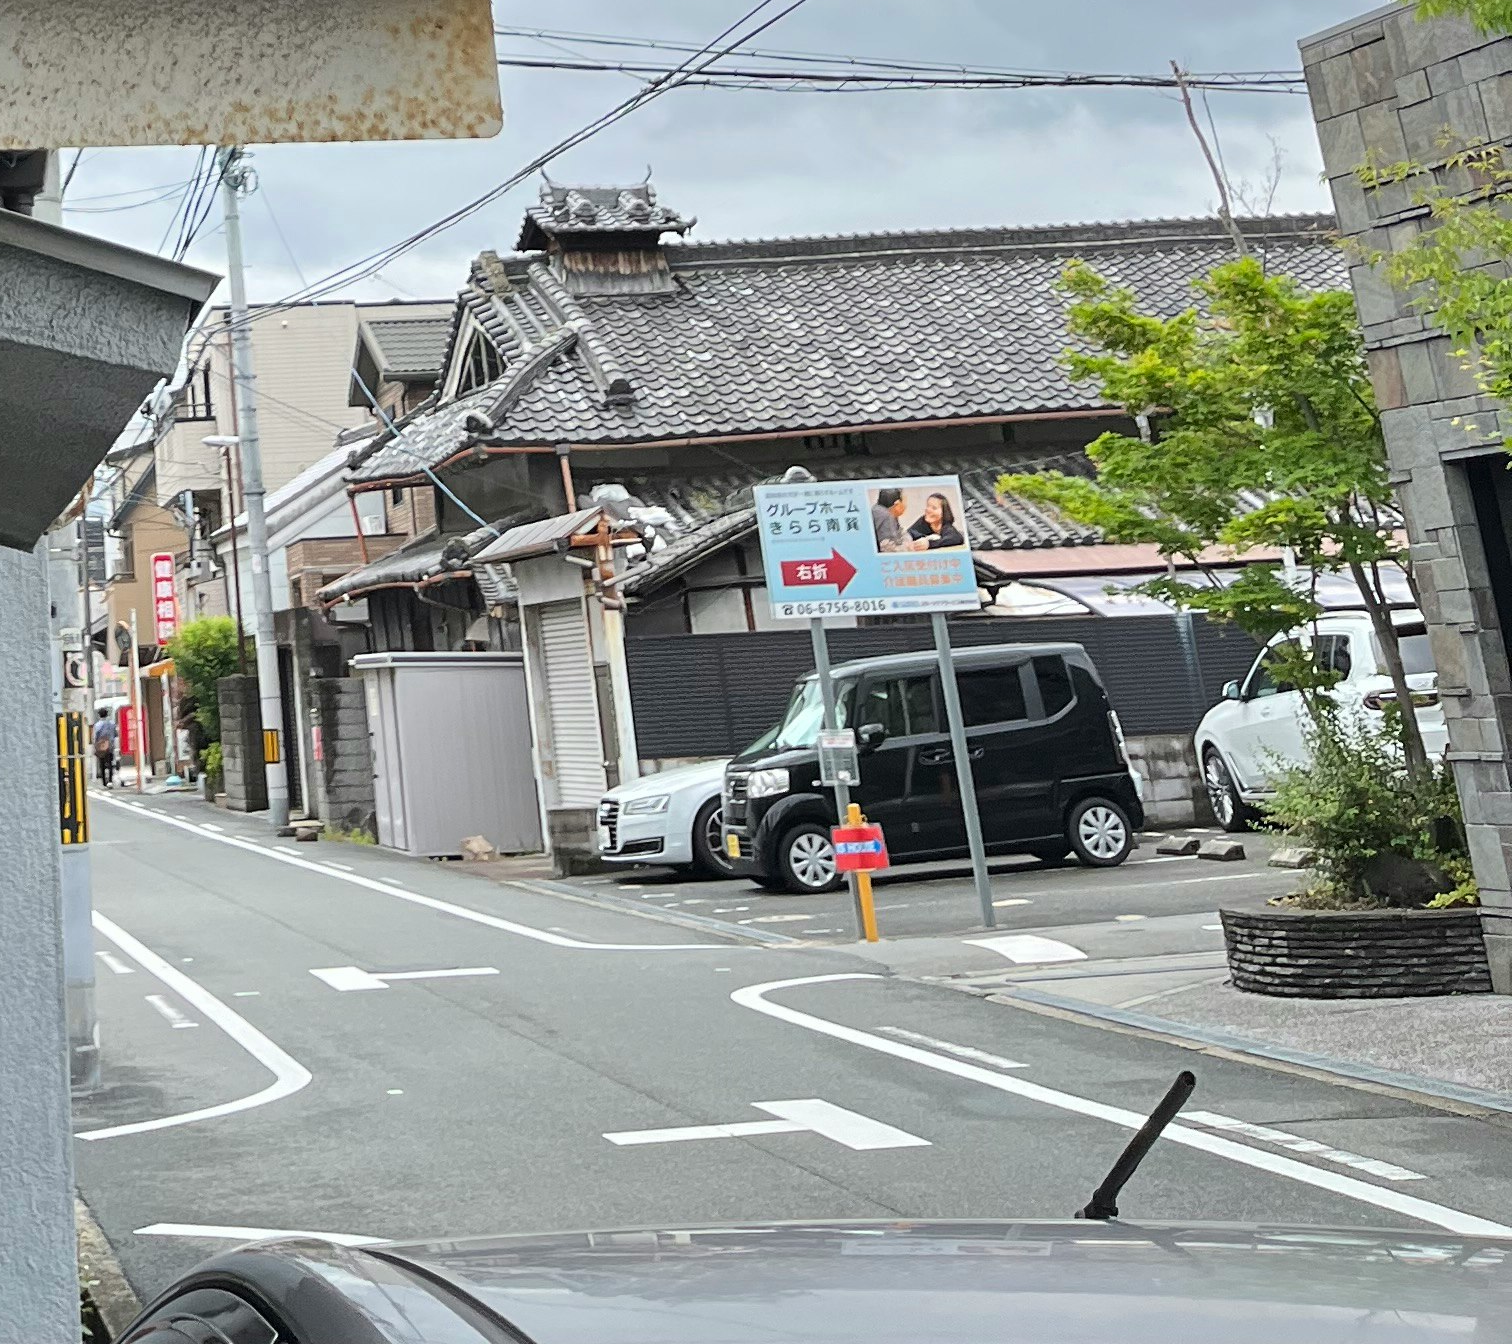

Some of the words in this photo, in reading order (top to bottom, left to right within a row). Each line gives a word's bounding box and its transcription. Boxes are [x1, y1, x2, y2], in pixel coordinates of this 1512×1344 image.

[766, 500, 860, 517] グループホーム
[796, 563, 828, 581] 右折
[797, 599, 886, 615] 06-6756-8016
